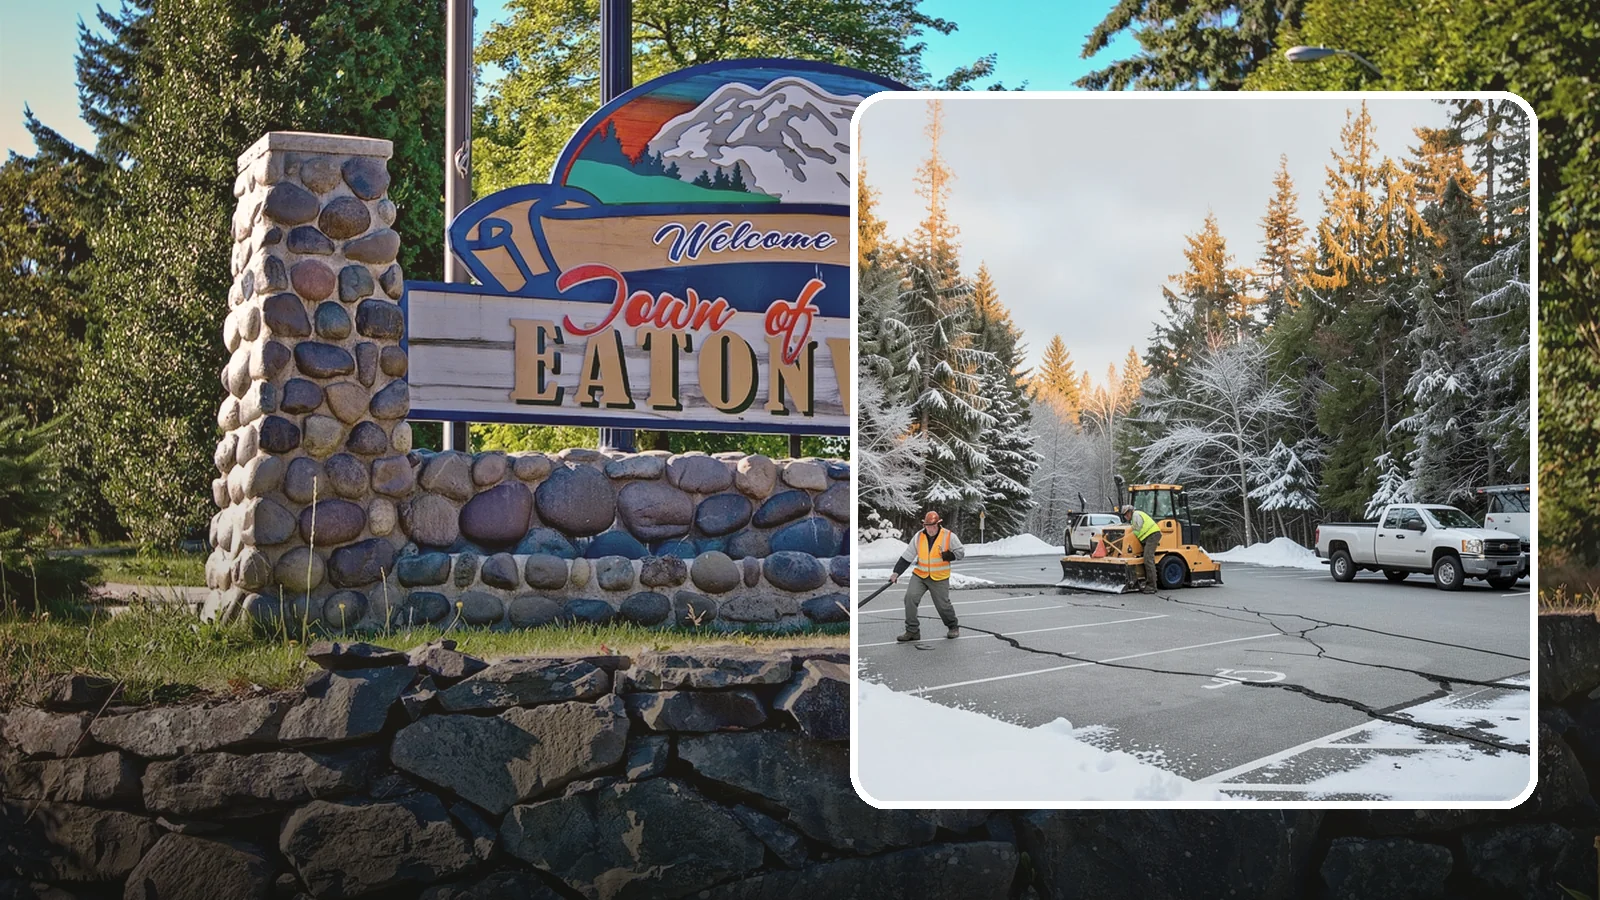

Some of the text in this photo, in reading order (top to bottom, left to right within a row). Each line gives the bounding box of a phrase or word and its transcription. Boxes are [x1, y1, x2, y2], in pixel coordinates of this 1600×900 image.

[653, 220, 837, 263] Welcome
[556, 263, 826, 365] Town of
